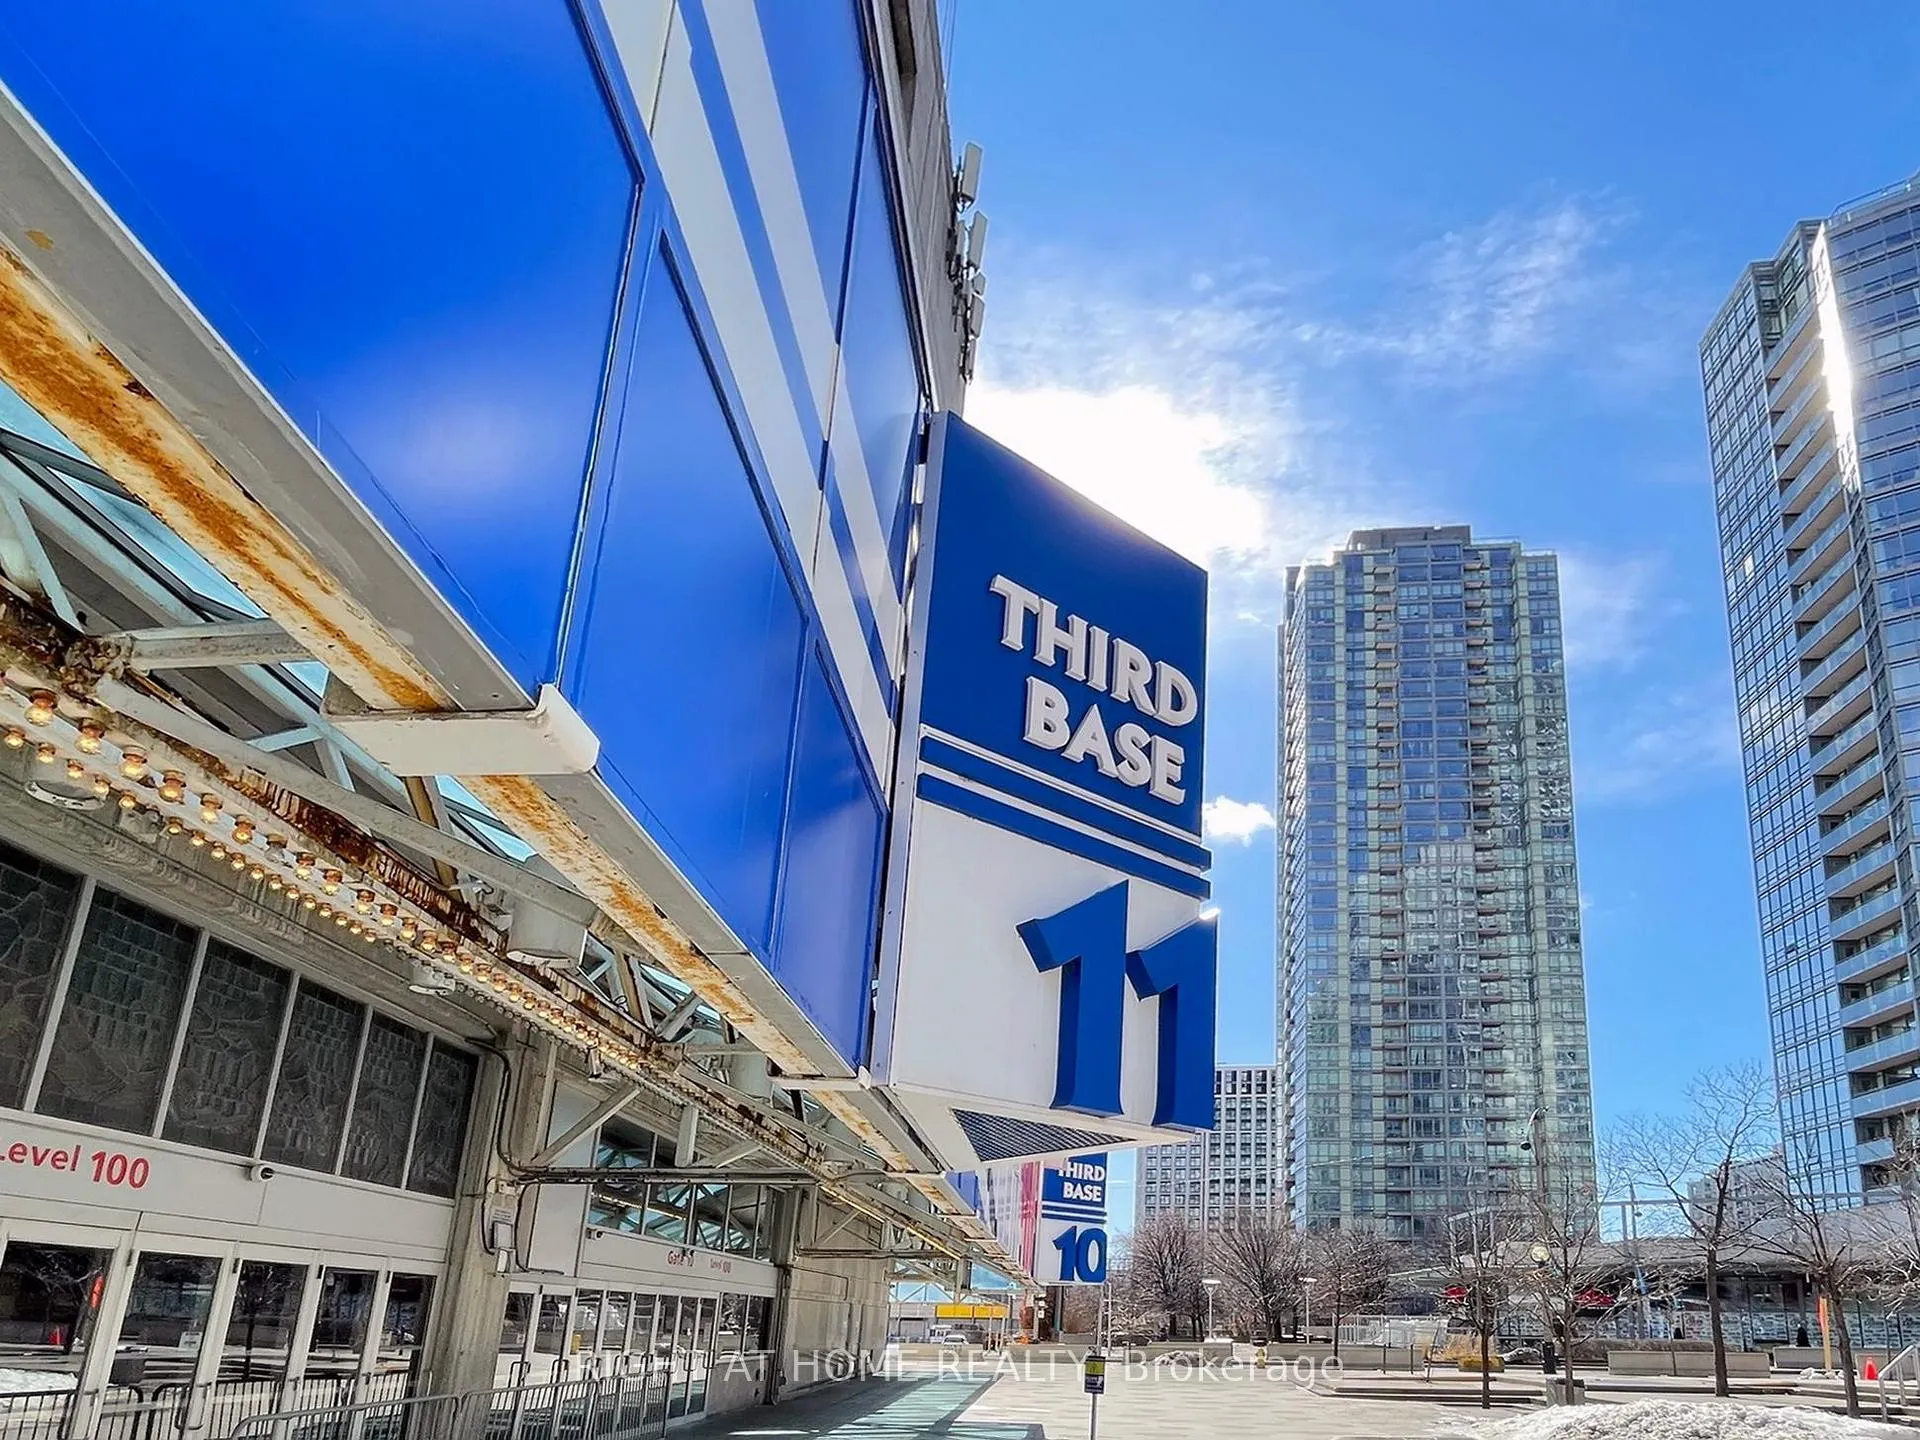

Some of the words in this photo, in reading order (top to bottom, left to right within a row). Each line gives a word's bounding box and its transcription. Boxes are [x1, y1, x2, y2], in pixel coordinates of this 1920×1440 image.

[990, 574, 1198, 727] THIRD
[1023, 676, 1186, 805] BASE
[1015, 879, 1218, 1131] 11
[0, 1142, 82, 1172] evel
[91, 1151, 150, 1189] 100
[1063, 1181, 1103, 1202] BASE
[1052, 1225, 1108, 1283] 10
